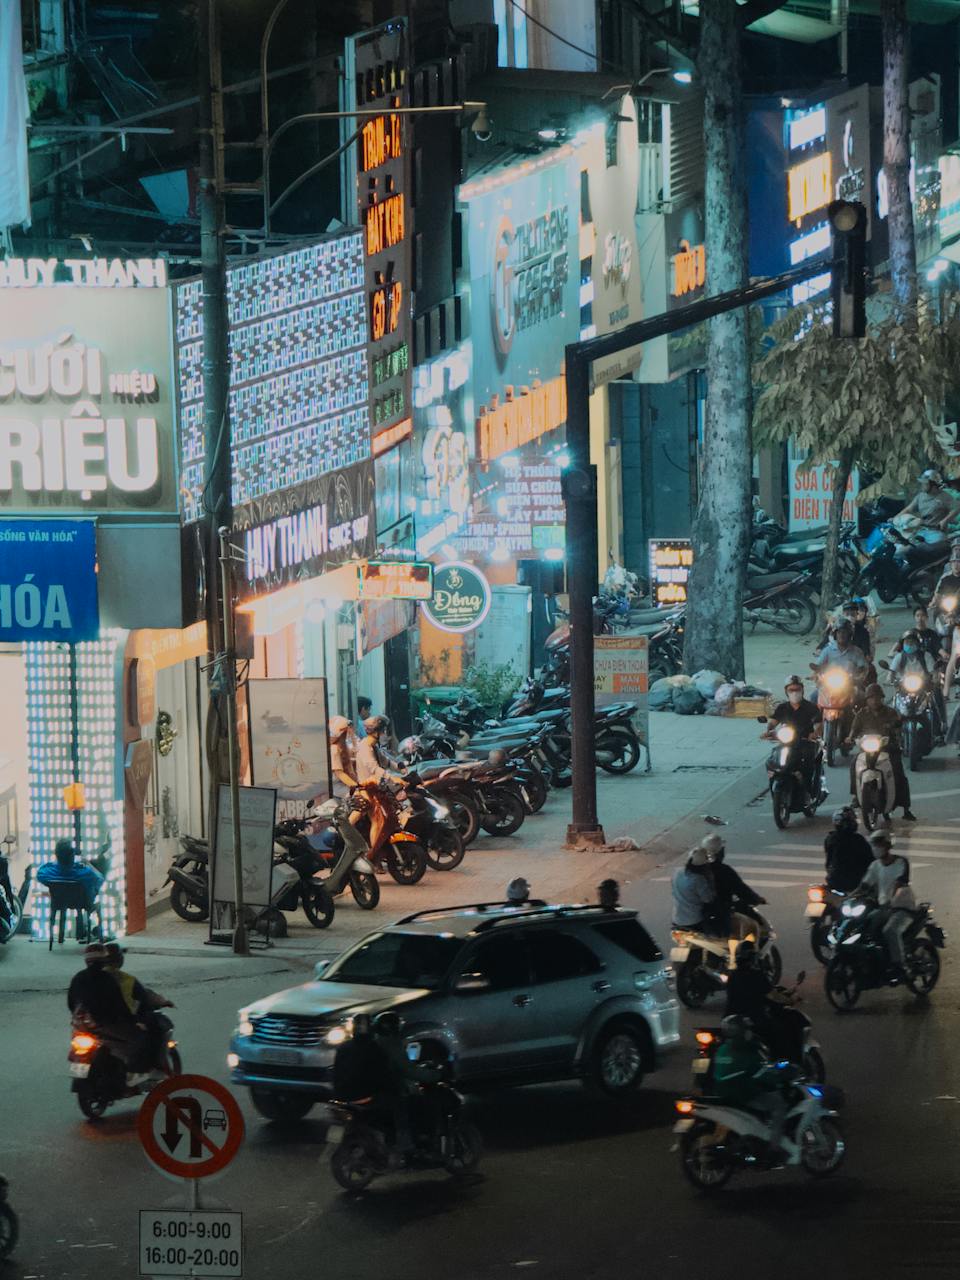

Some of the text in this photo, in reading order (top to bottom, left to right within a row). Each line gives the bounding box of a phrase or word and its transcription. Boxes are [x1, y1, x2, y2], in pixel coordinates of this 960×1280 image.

[64, 258, 167, 288] THANH
[109, 369, 156, 397] HIỆU
[28, 529, 50, 542] VĂN
[246, 520, 278, 581] HUY
[278, 503, 328, 569] THANH
[153, 1221, 231, 1239] 6:00-9:00
[145, 1246, 240, 1267] 16:00-20:00
